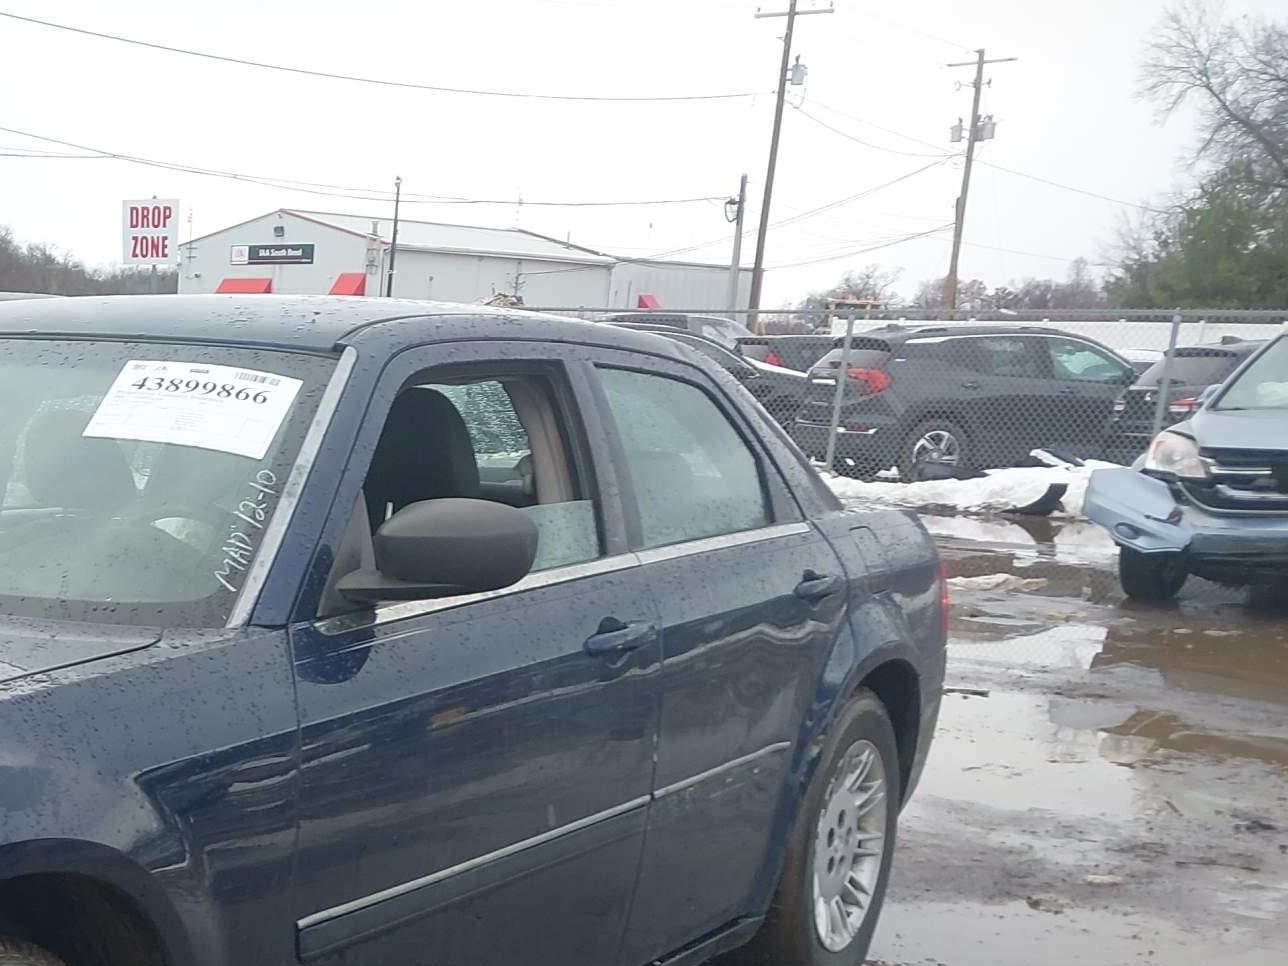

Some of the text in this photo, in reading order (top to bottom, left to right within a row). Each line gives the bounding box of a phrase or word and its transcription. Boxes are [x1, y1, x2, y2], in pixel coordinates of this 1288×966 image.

[129, 205, 172, 229] DROP
[131, 235, 169, 258] ZONE
[131, 376, 273, 405] 43899866
